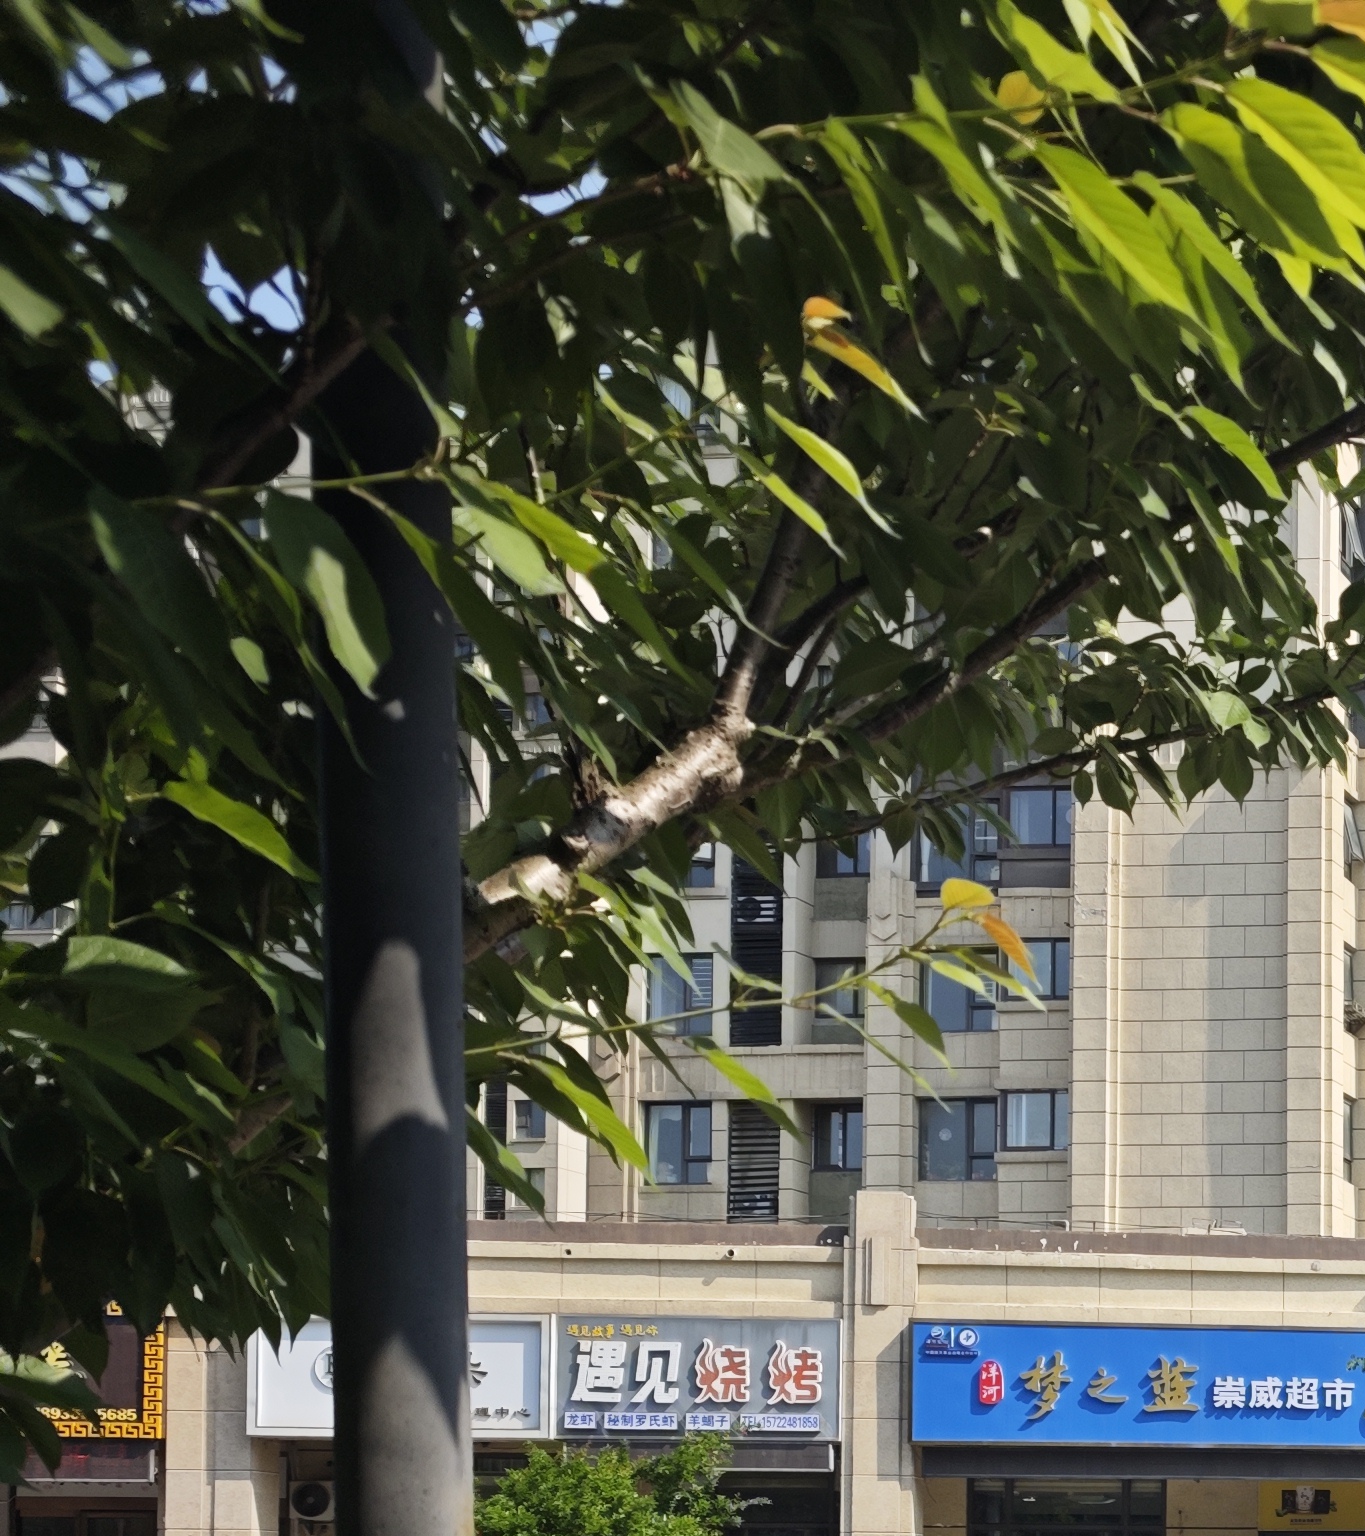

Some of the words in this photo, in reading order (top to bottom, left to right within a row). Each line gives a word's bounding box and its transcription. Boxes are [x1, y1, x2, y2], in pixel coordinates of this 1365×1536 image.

[570, 1338, 824, 1405] 遇见烧烤
[981, 1362, 1001, 1402] 洋河
[1020, 1350, 1200, 1421] 梦之蓝
[1213, 1376, 1356, 1411] 崇威超市
[566, 1414, 595, 1427] 龙虾
[606, 1414, 676, 1429] 秘制罗氏虾
[687, 1415, 730, 1429] 羊蝎子
